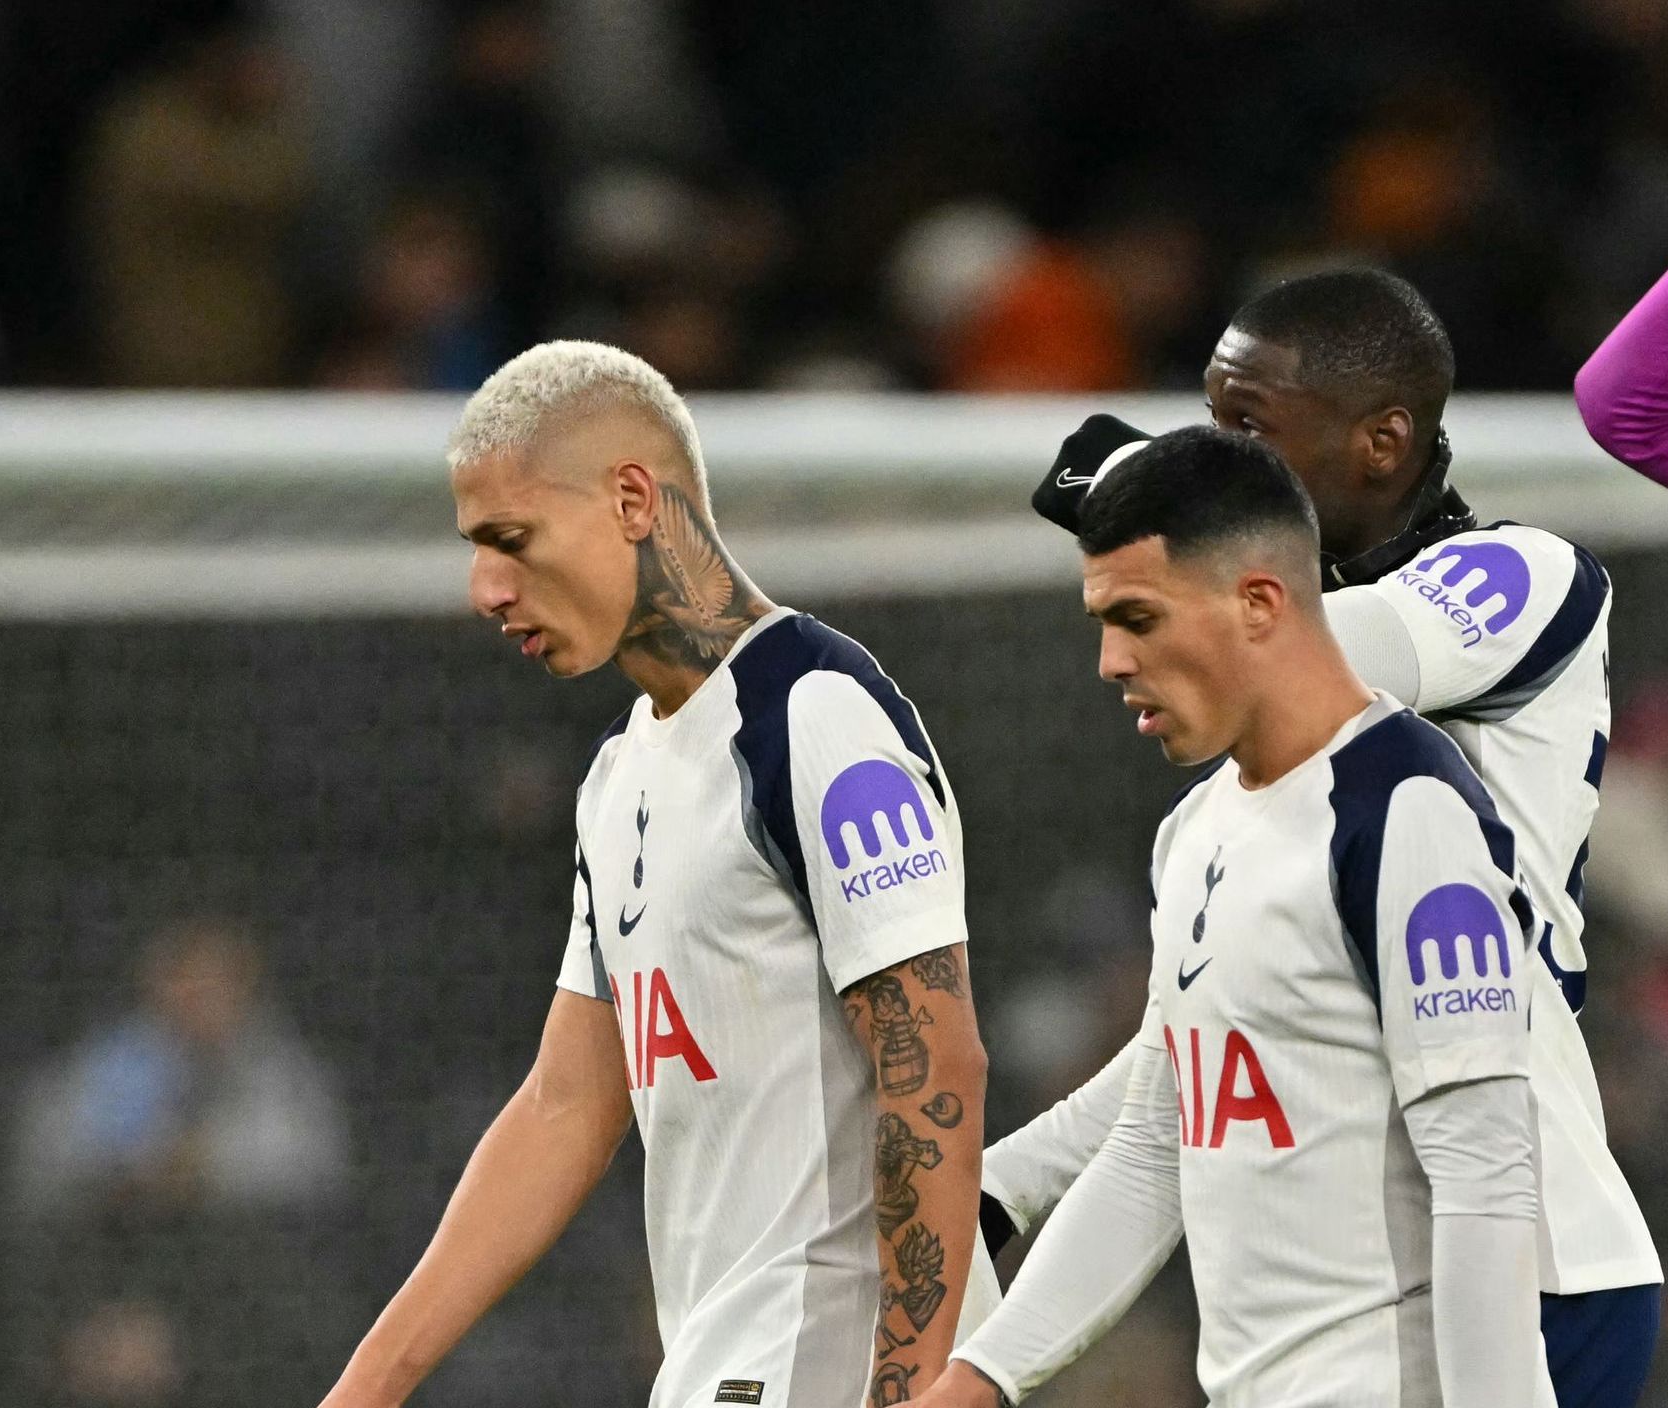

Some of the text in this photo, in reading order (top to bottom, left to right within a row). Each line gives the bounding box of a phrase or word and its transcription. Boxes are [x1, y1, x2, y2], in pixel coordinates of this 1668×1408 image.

[1397, 570, 1482, 648] kraken
[840, 849, 947, 903] kraken
[1414, 987, 1517, 1020] kraken
